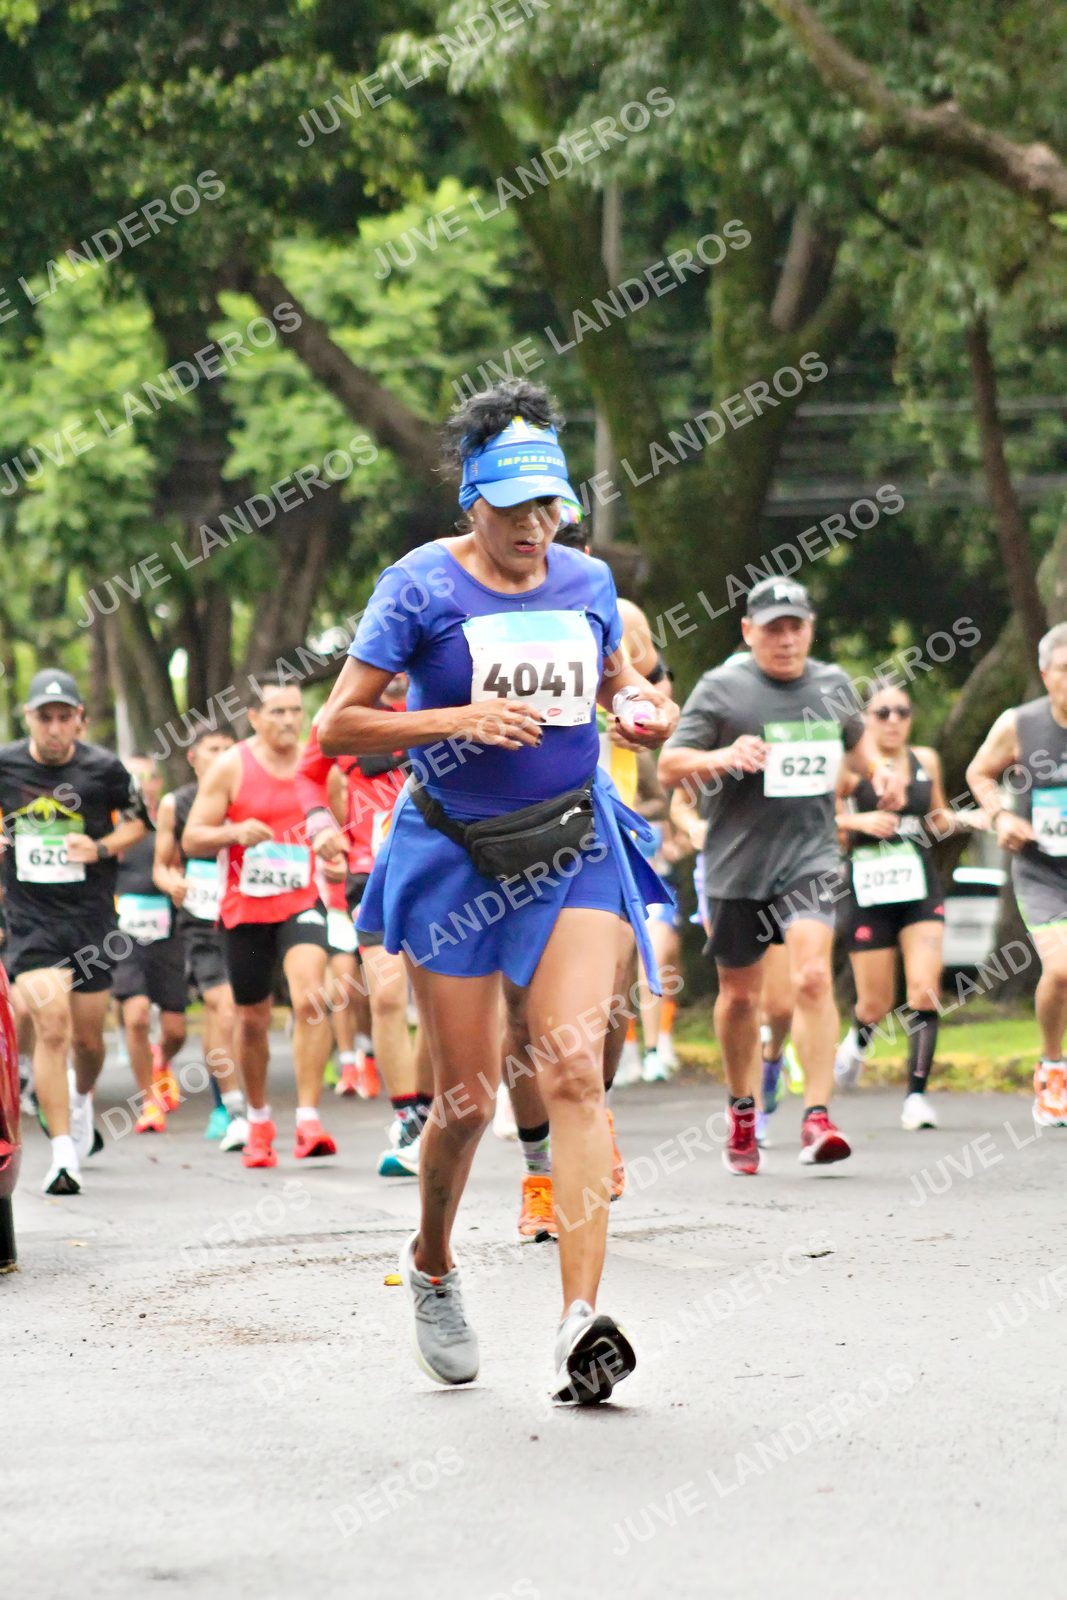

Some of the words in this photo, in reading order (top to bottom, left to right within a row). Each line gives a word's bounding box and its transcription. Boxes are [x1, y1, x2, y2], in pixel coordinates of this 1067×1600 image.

[482, 661, 584, 698] 4041
[781, 755, 827, 777] 622
[862, 868, 913, 889] 2027
